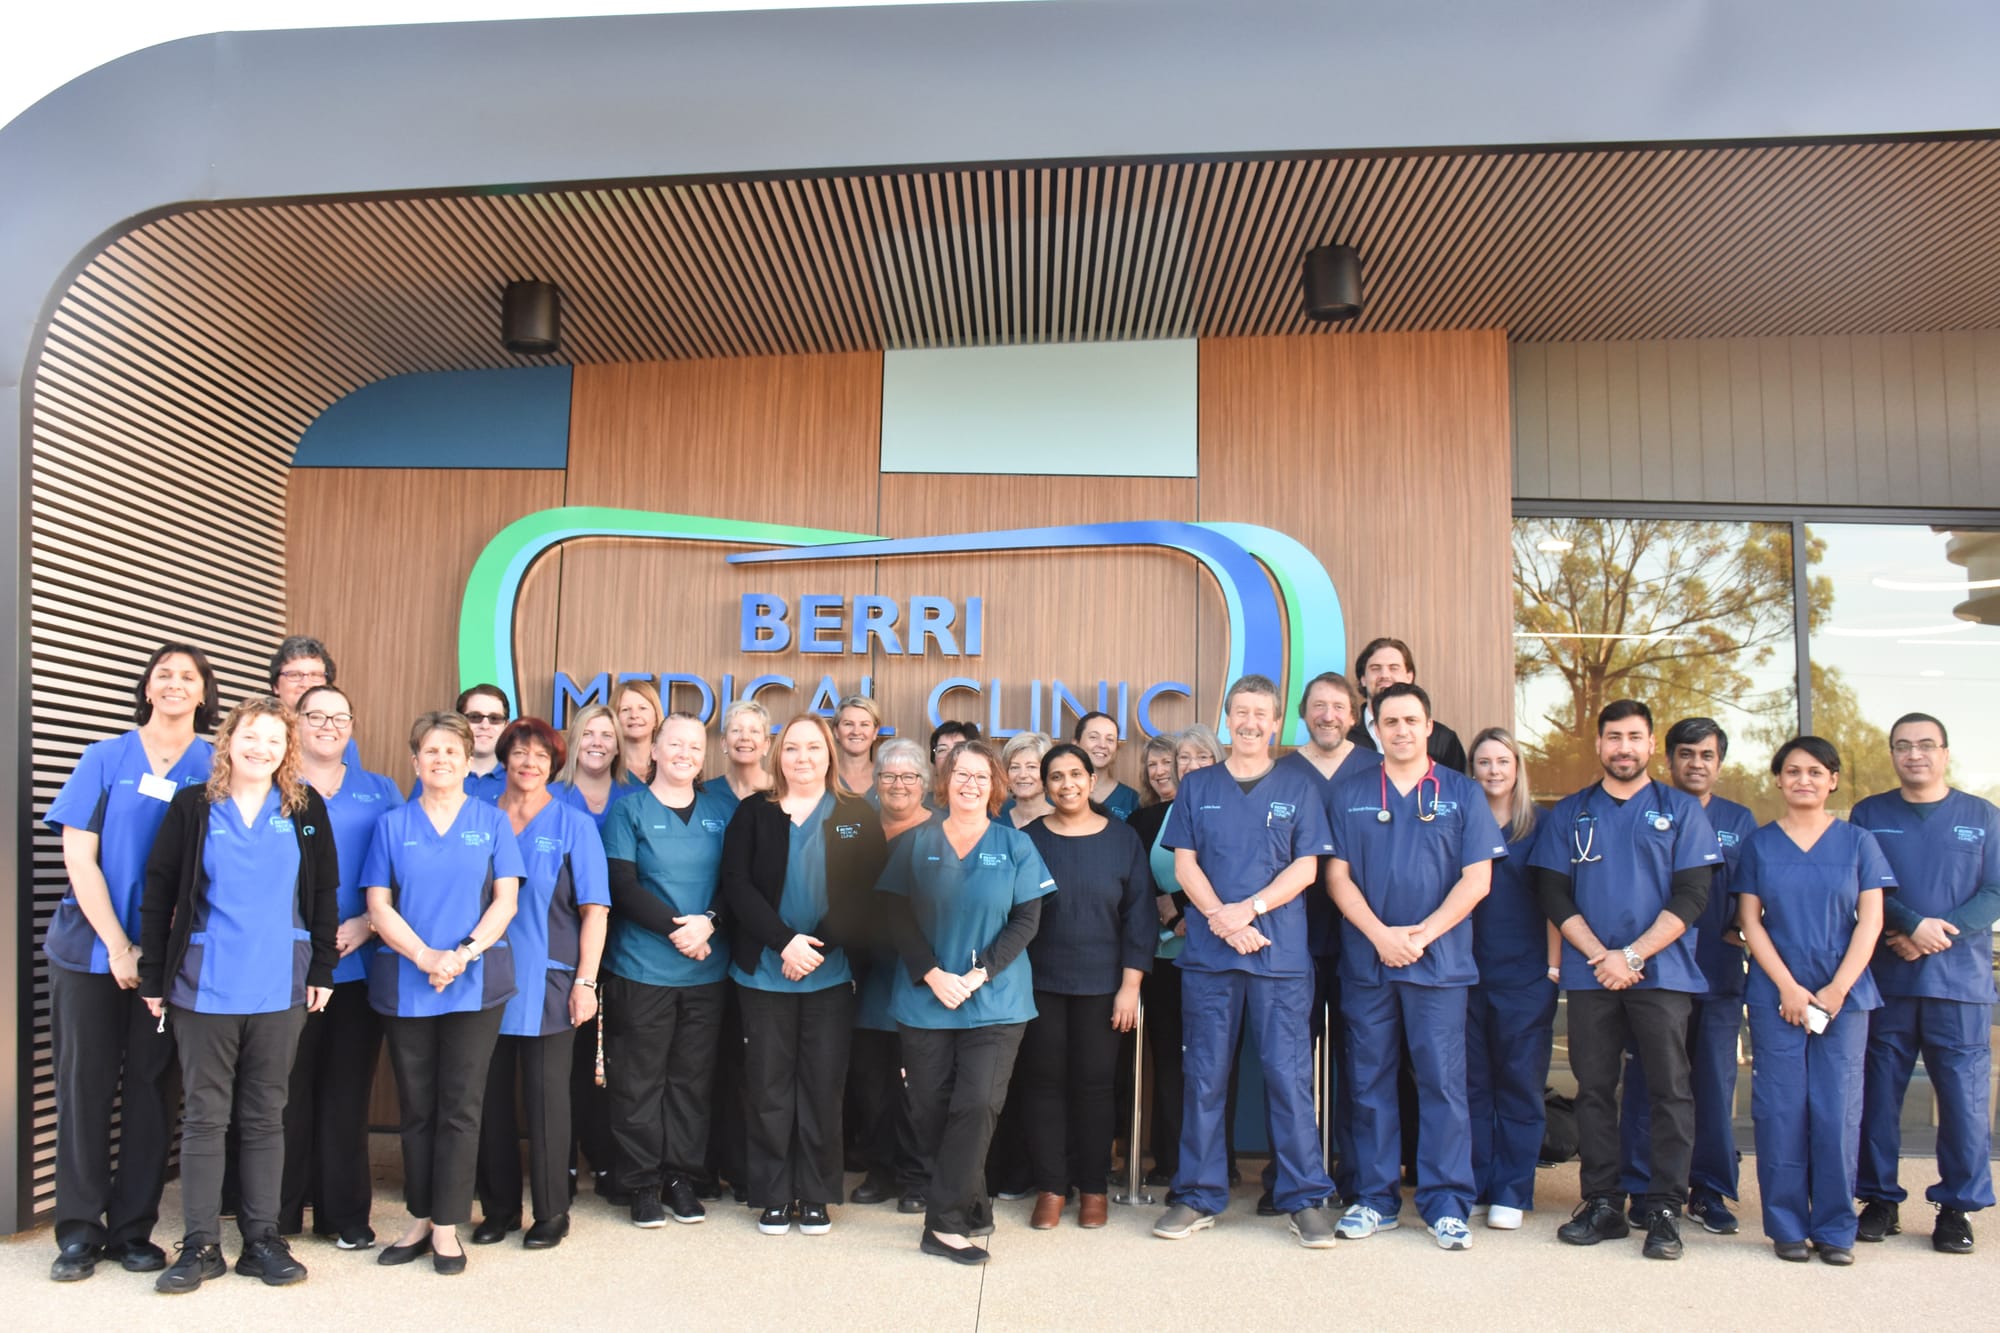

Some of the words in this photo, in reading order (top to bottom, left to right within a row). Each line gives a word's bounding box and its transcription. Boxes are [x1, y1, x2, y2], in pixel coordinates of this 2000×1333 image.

[741, 593, 982, 656] BERRI
[553, 672, 896, 737] MDICA
[928, 677, 1192, 741] CLINIC
